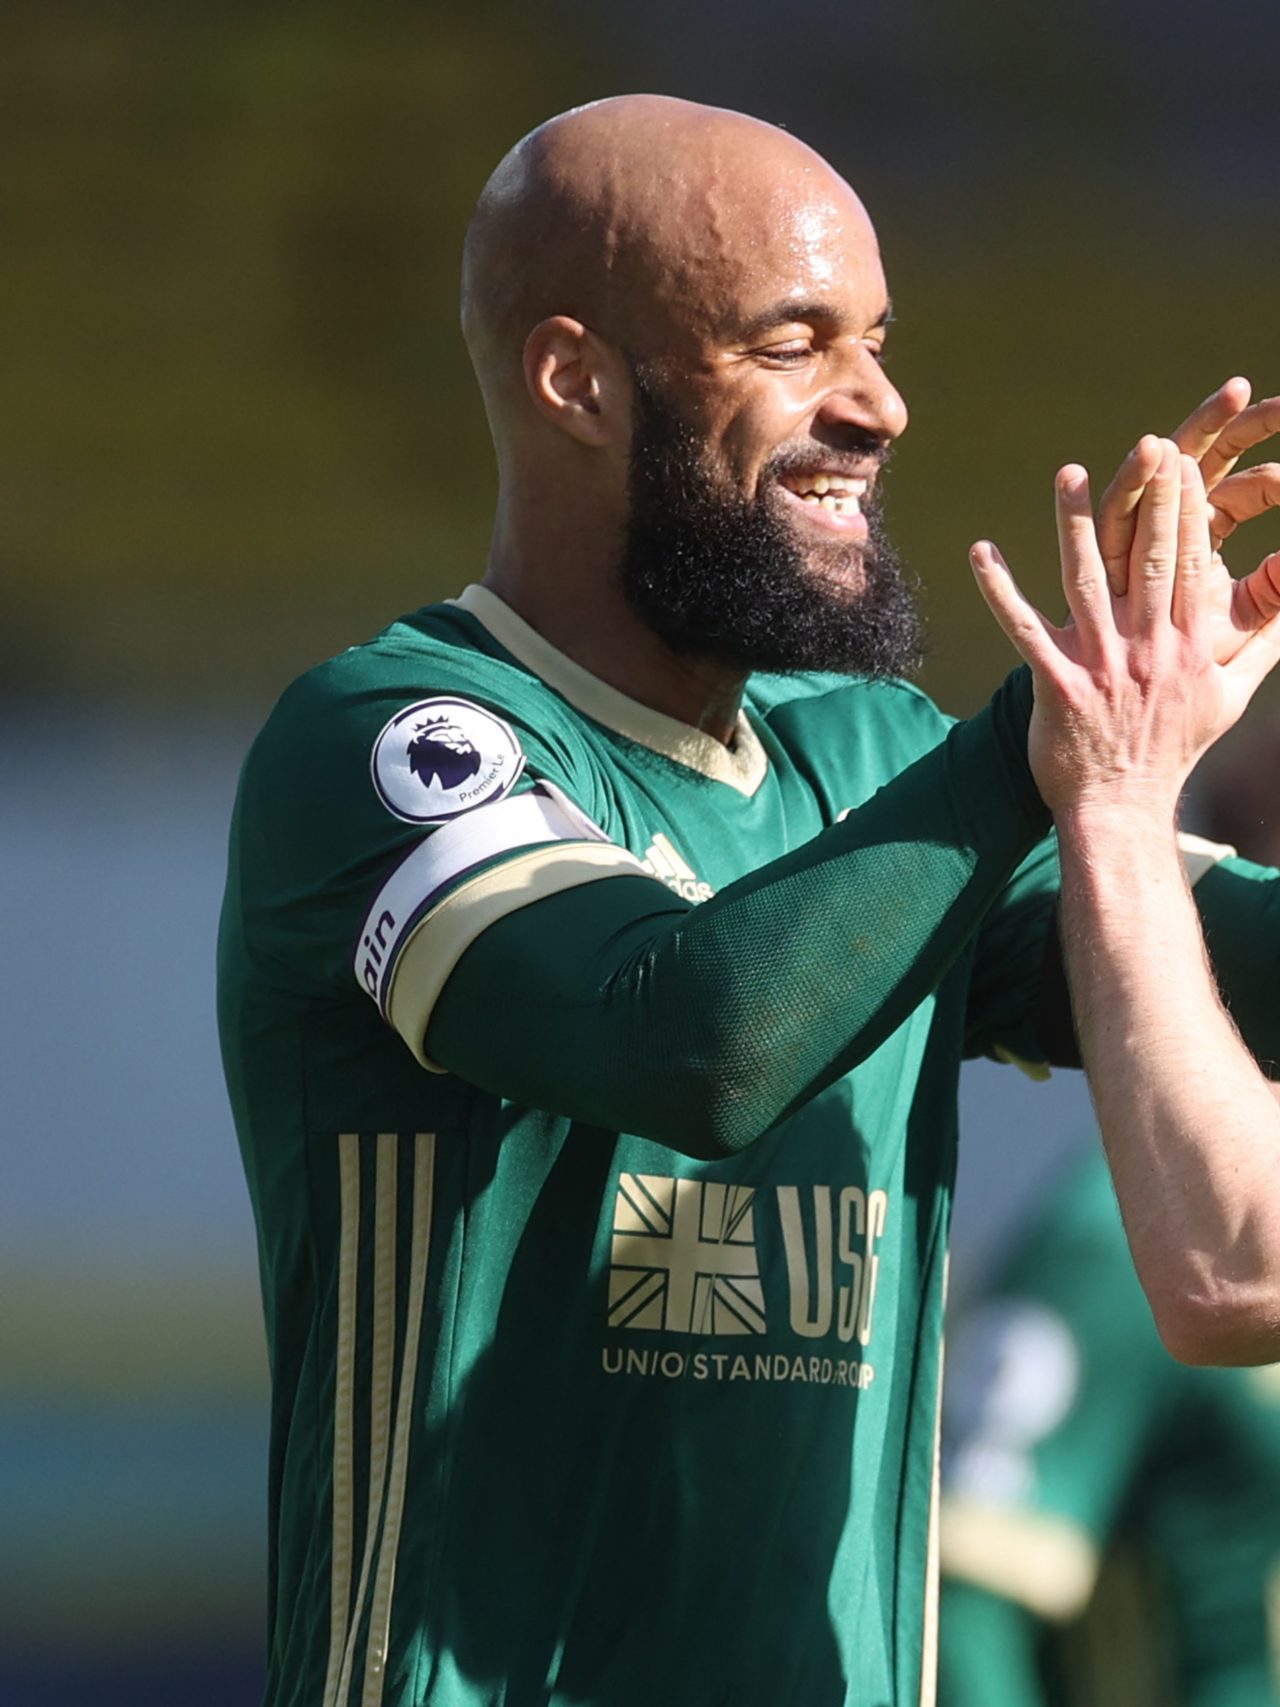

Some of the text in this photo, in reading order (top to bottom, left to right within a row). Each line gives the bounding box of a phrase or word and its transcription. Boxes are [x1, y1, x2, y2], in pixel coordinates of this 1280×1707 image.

[459, 768, 499, 801] Premier
[601, 1347, 689, 1378] UNIO
[692, 1353, 832, 1384] STANDARD
